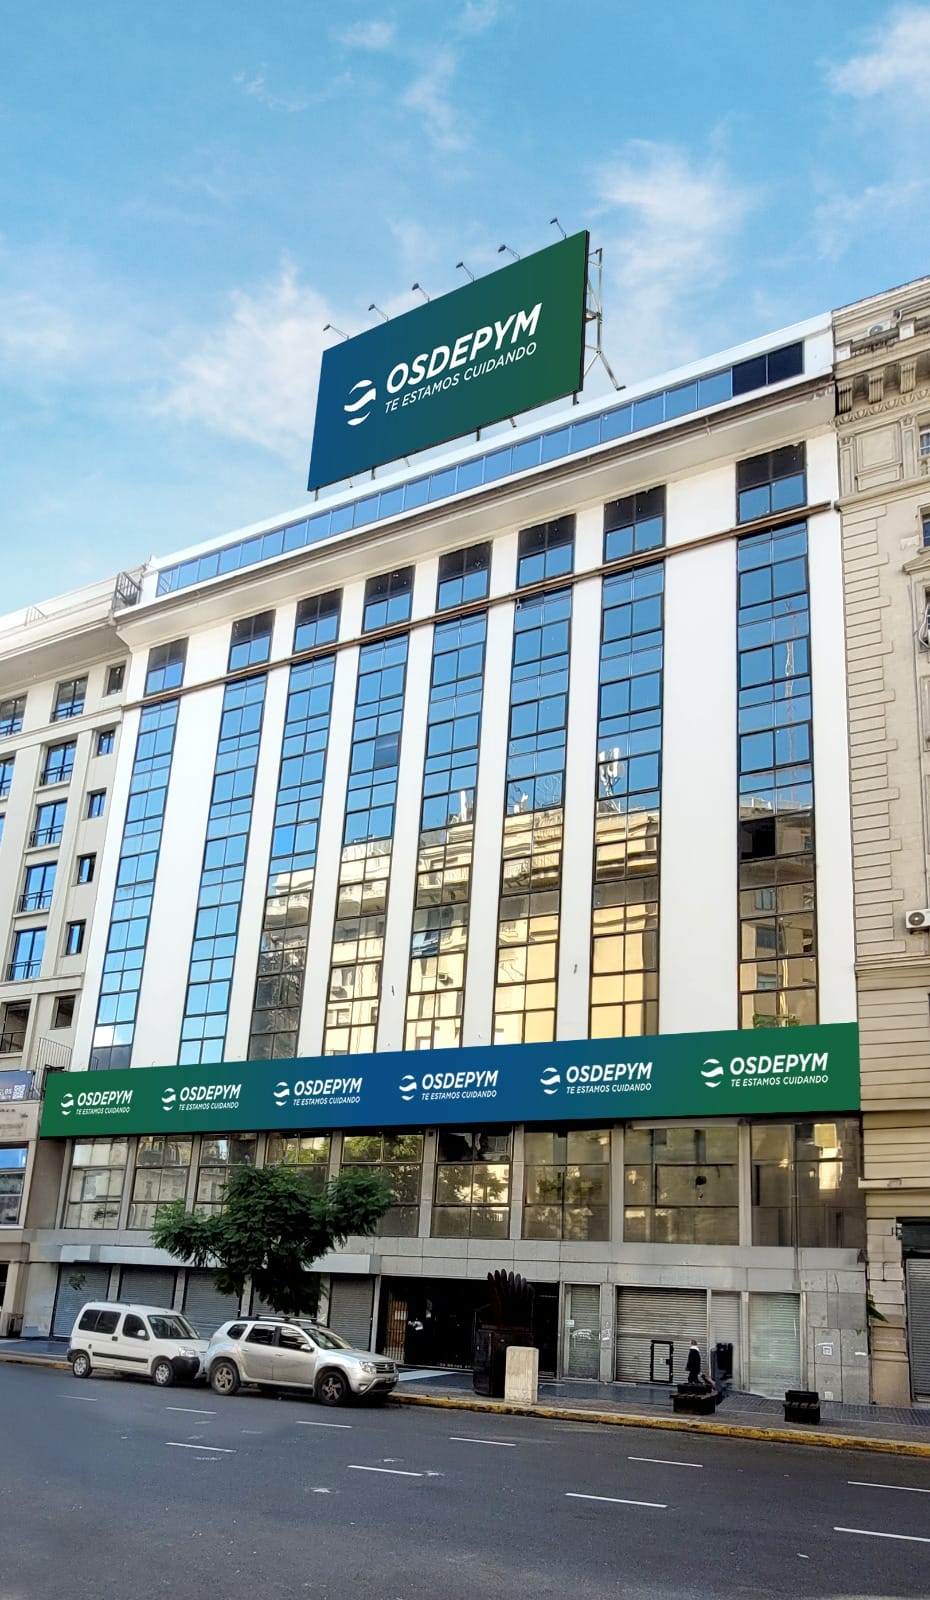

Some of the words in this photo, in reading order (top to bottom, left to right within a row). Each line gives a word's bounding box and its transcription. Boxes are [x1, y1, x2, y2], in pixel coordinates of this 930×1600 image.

[386, 302, 543, 394] OSDEPYM
[385, 397, 400, 414] TE
[402, 373, 460, 407] ESTAMOS
[463, 341, 537, 381] CUIDANDO
[566, 1062, 653, 1083] OSDEPYM
[730, 1052, 829, 1076] OSDEPYM
[294, 1077, 363, 1096] OSDEPYM
[421, 1070, 499, 1090] OSDEPYM
[566, 1086, 576, 1094] TE
[576, 1084, 610, 1094] ESTAMOS
[611, 1082, 652, 1092] CUIDANDO
[731, 1078, 742, 1087] TE
[742, 1077, 781, 1087] ESTAMOS
[782, 1075, 829, 1085] CUIDANDO
[77, 1090, 133, 1107] OSDEPYM
[180, 1084, 242, 1102] OSDEPYM
[293, 1098, 300, 1106] TE
[300, 1097, 328, 1106] ESTAMOS
[328, 1096, 361, 1105] CUIDANDO
[421, 1092, 430, 1100] TE
[430, 1091, 461, 1100] ESTAMOS
[461, 1089, 497, 1099] CUIDANDO
[82, 1107, 104, 1115] ESTAMOS
[104, 1106, 131, 1114] CUIDANDO
[179, 1103, 186, 1111] TE
[186, 1102, 210, 1110] ESTAMOS
[210, 1101, 239, 1109] CUIDANDO
